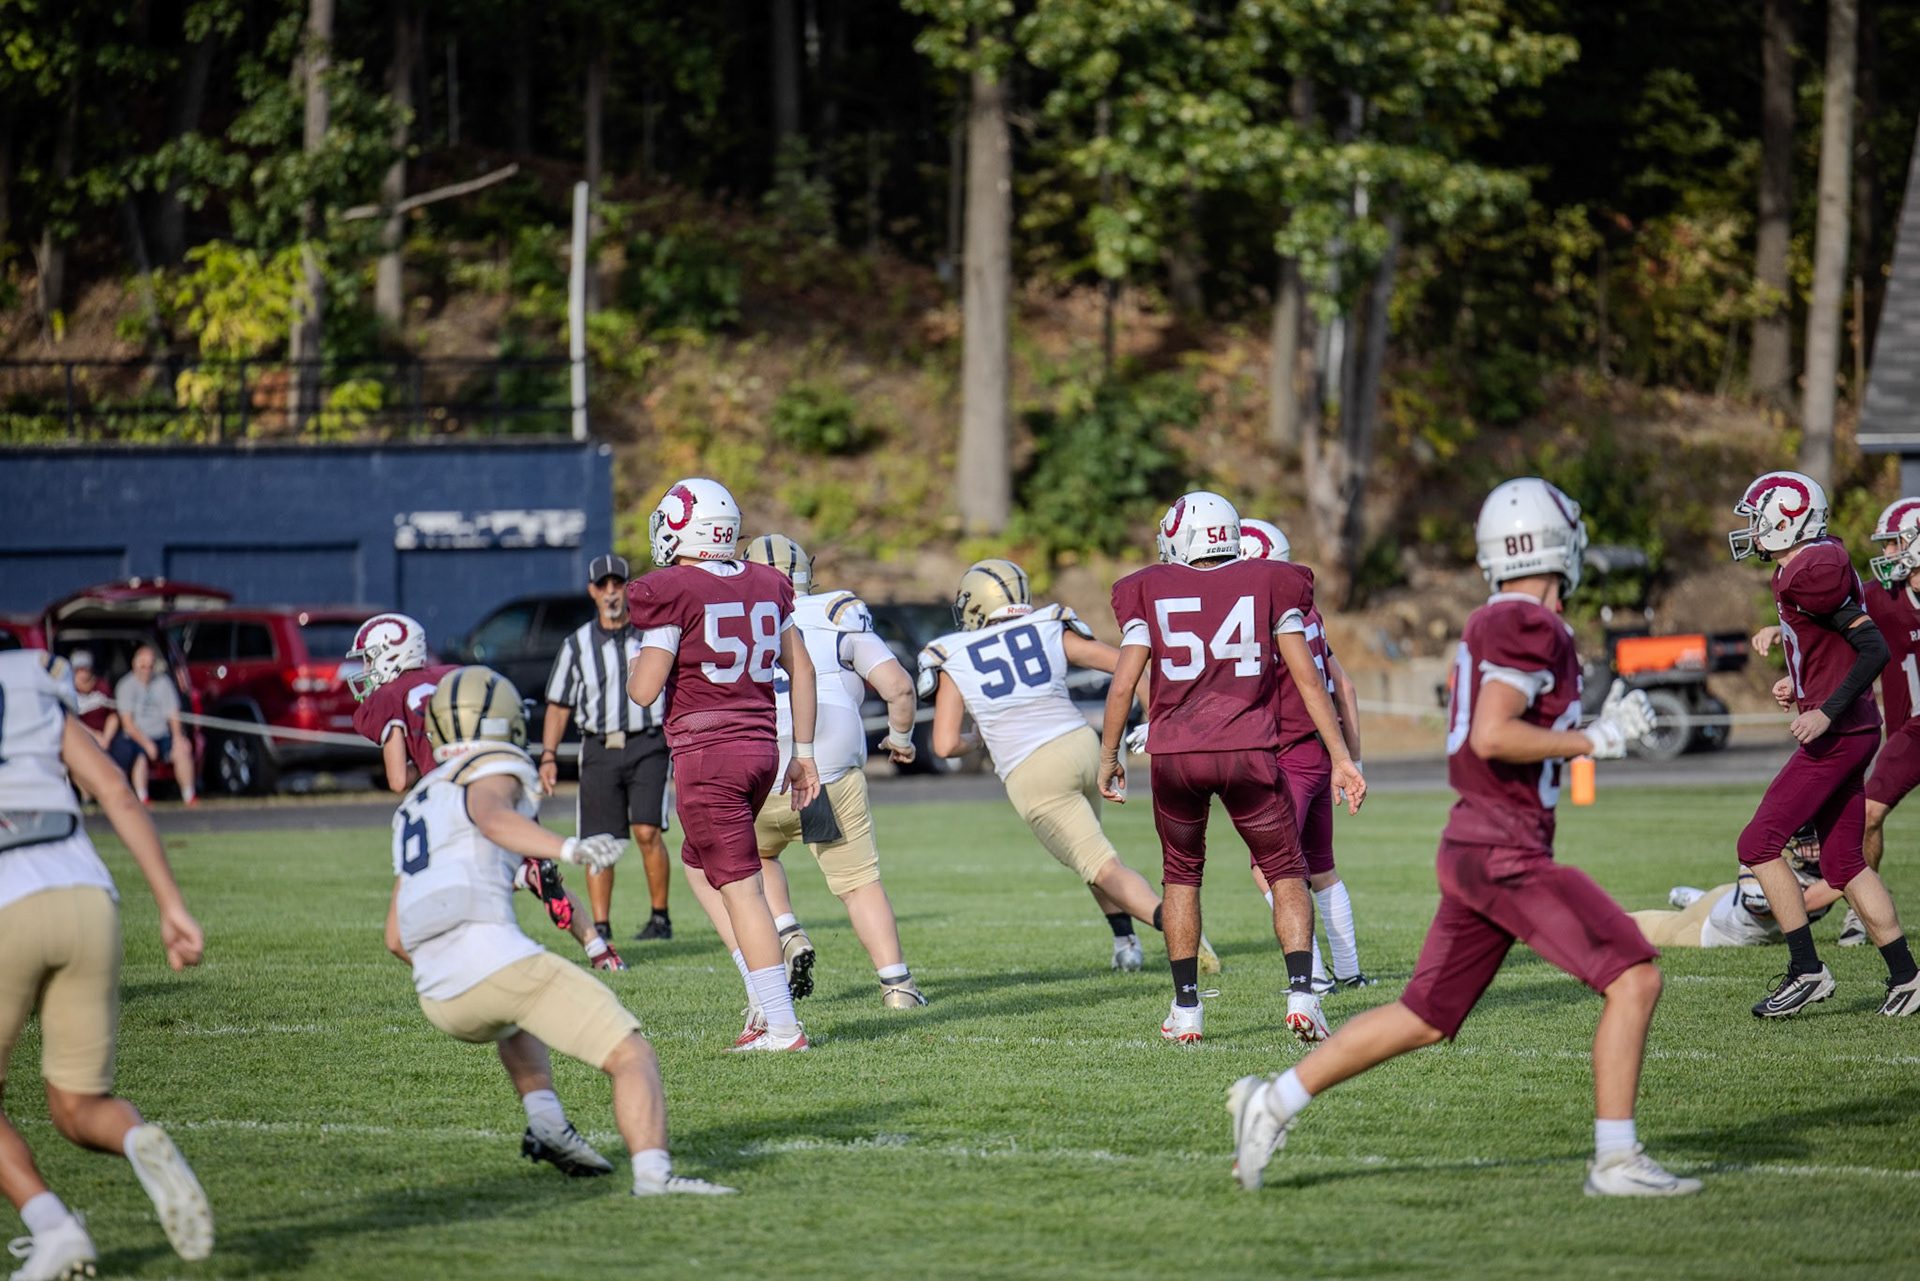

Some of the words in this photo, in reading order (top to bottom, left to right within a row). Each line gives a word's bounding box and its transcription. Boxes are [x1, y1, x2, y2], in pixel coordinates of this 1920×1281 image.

[713, 527, 734, 544] 58
[1206, 526, 1228, 544] 54
[1505, 533, 1534, 556] 80
[701, 601, 781, 684] 58
[966, 624, 1052, 700] 58
[1154, 595, 1262, 682] 54
